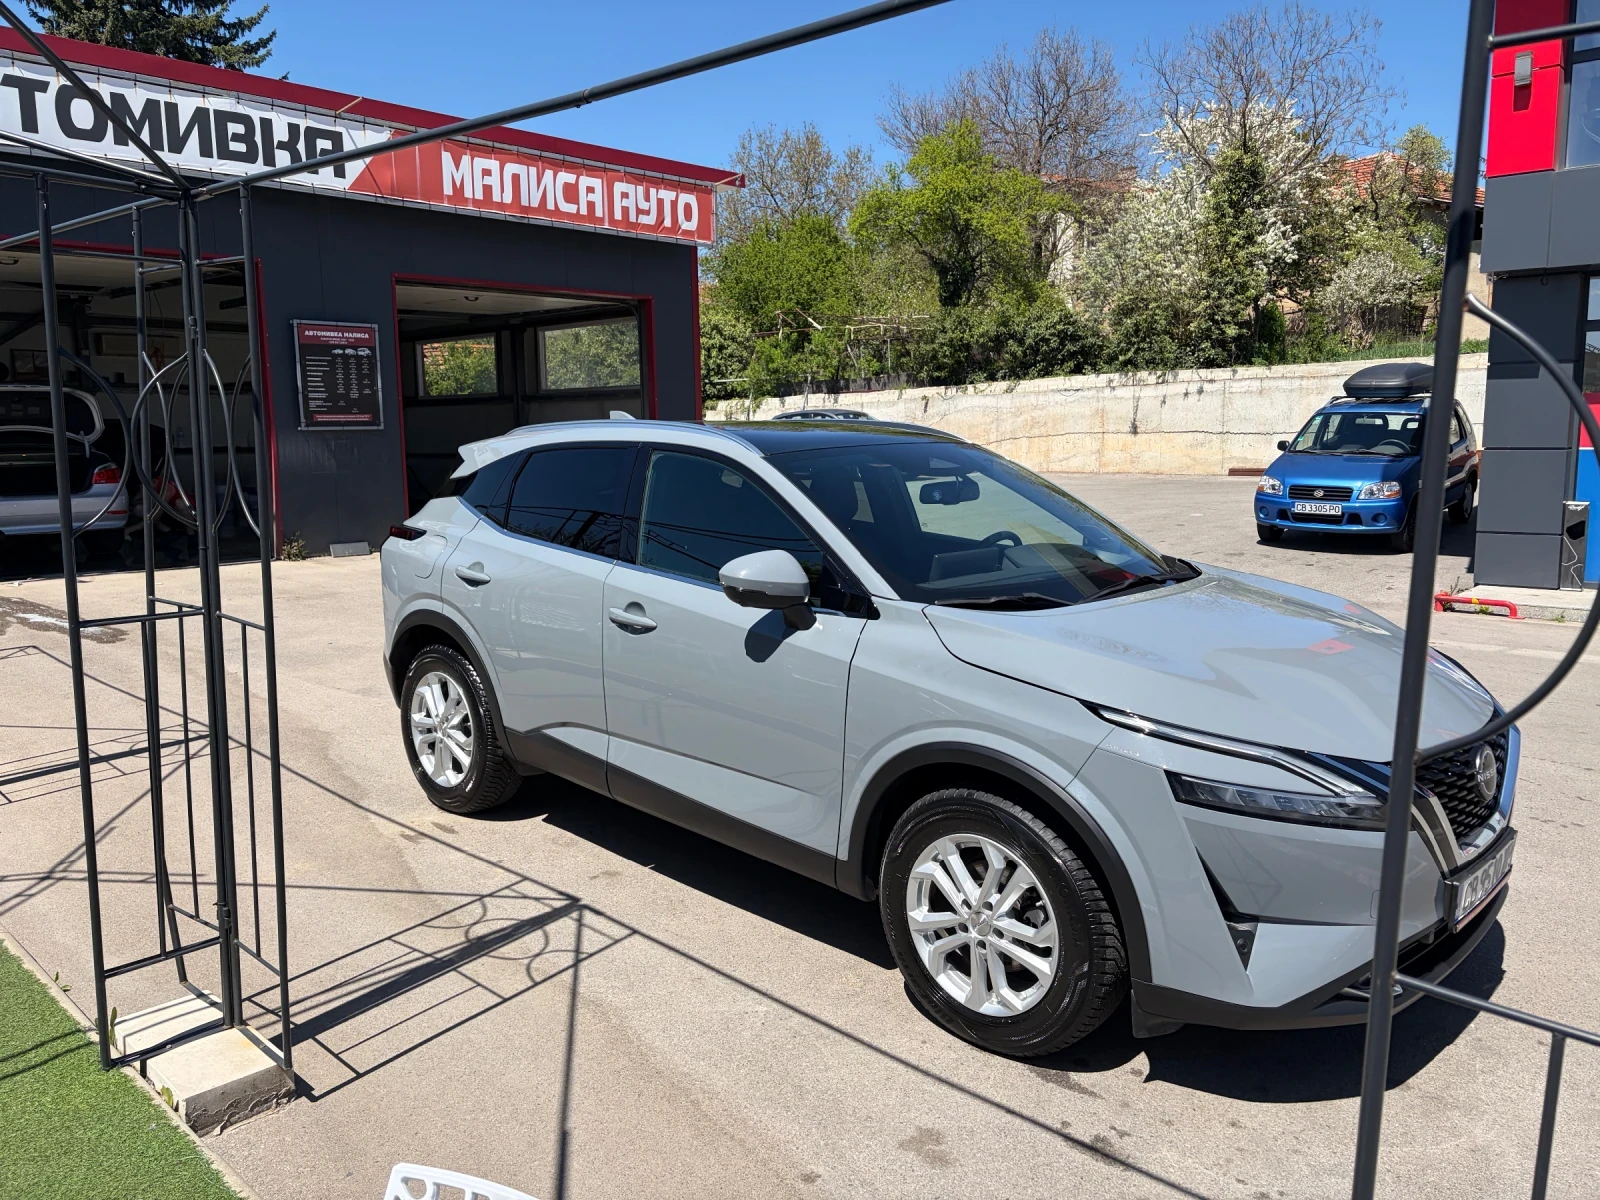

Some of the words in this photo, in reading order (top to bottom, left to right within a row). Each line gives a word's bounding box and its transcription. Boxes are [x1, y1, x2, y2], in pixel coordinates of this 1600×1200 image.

[441, 151, 604, 218] МАЛИСА
[613, 181, 699, 231] АУТО
[1296, 503, 1306, 511] CB
[1308, 504, 1327, 512] 3305
